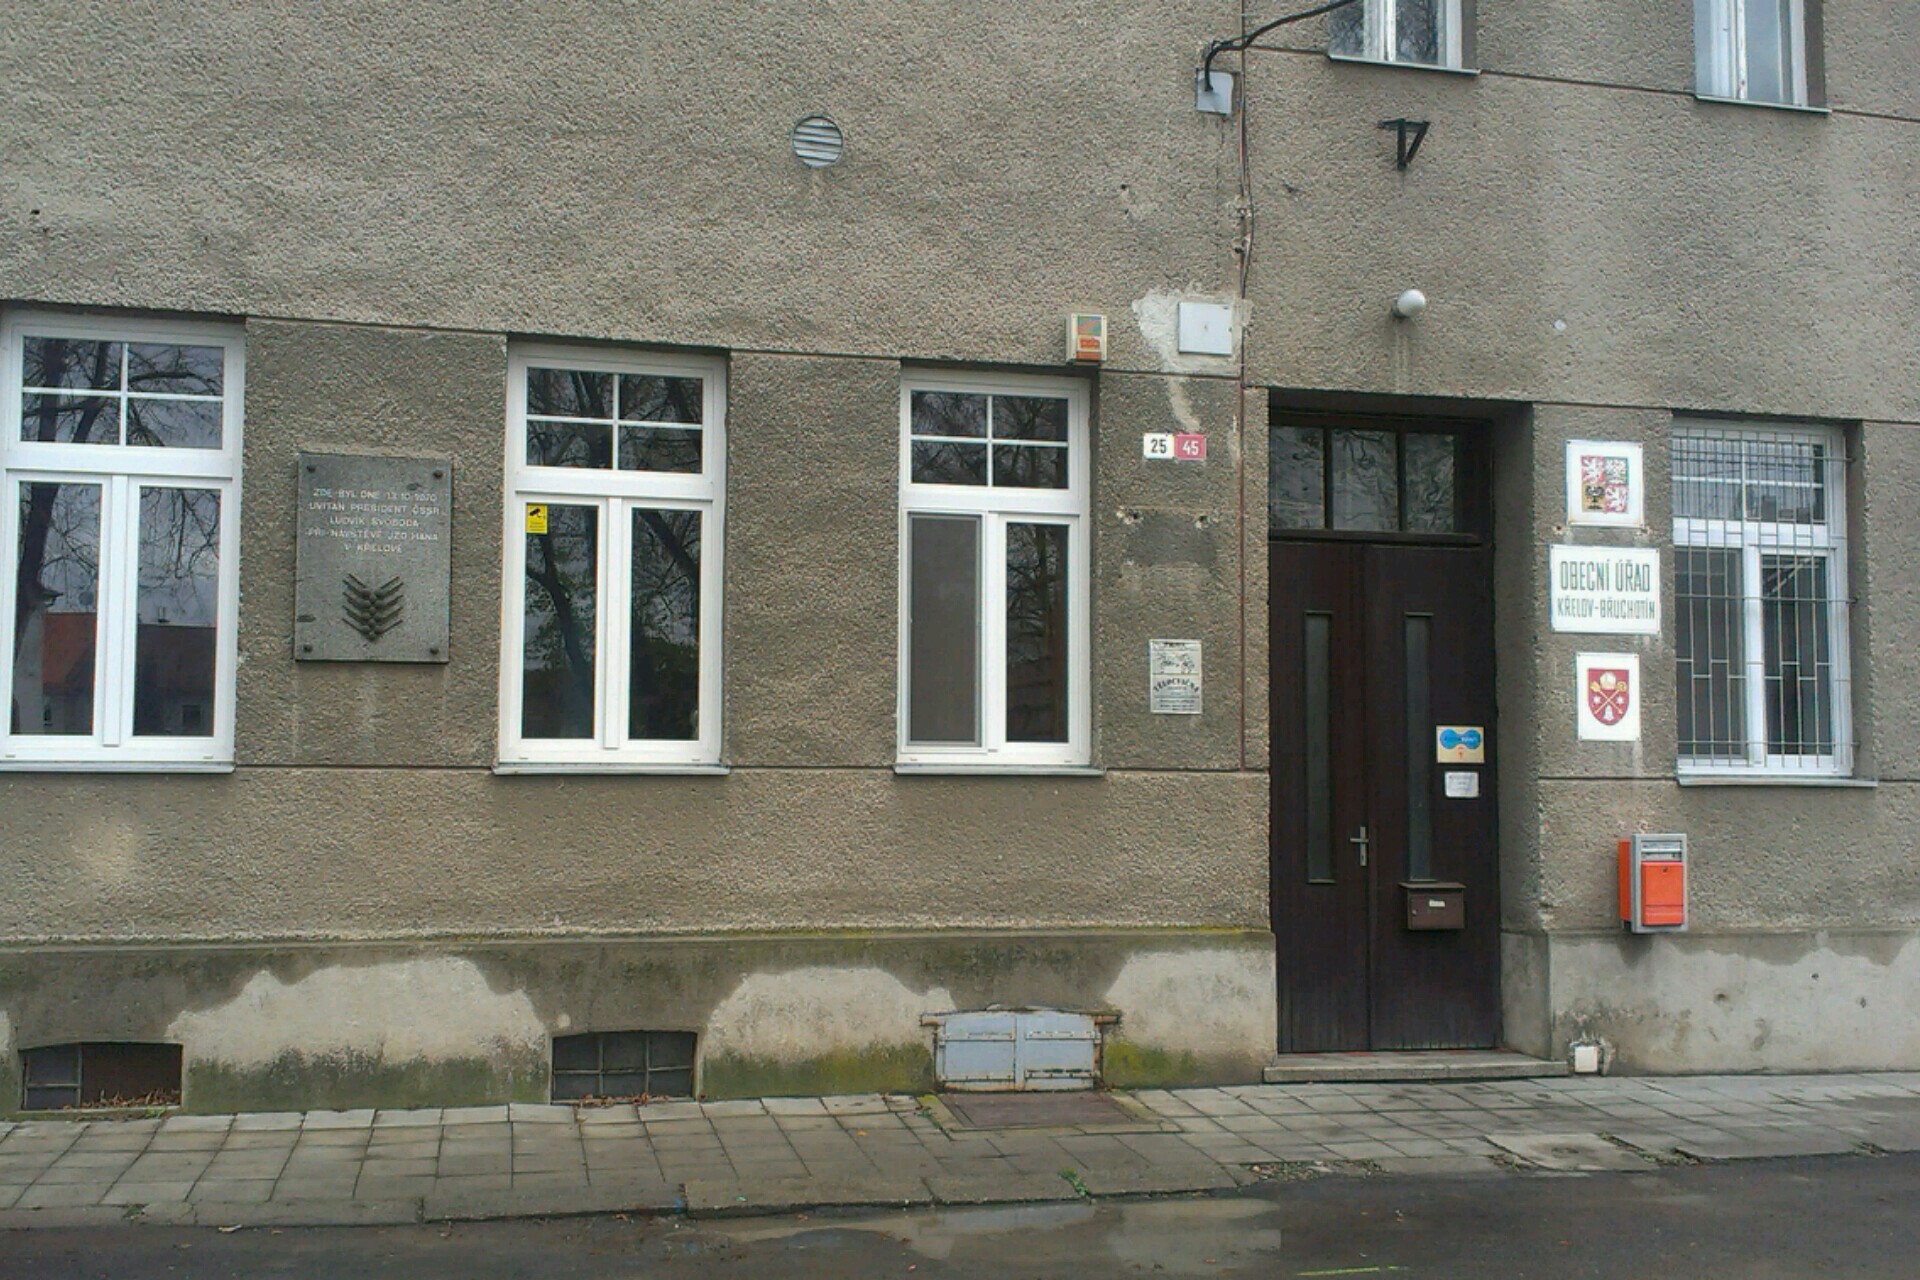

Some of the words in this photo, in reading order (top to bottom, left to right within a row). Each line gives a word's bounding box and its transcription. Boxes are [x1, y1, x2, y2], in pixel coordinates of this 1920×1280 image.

[1150, 438, 1167, 454] 25
[1181, 440, 1200, 456] 45
[312, 488, 333, 498] ZDE
[338, 489, 357, 498] BYL
[350, 503, 408, 513] PRESIDENT
[370, 517, 419, 528] SVOBODA
[1560, 558, 1610, 592] OBECNÍ
[1614, 558, 1651, 593] ÚŘAD
